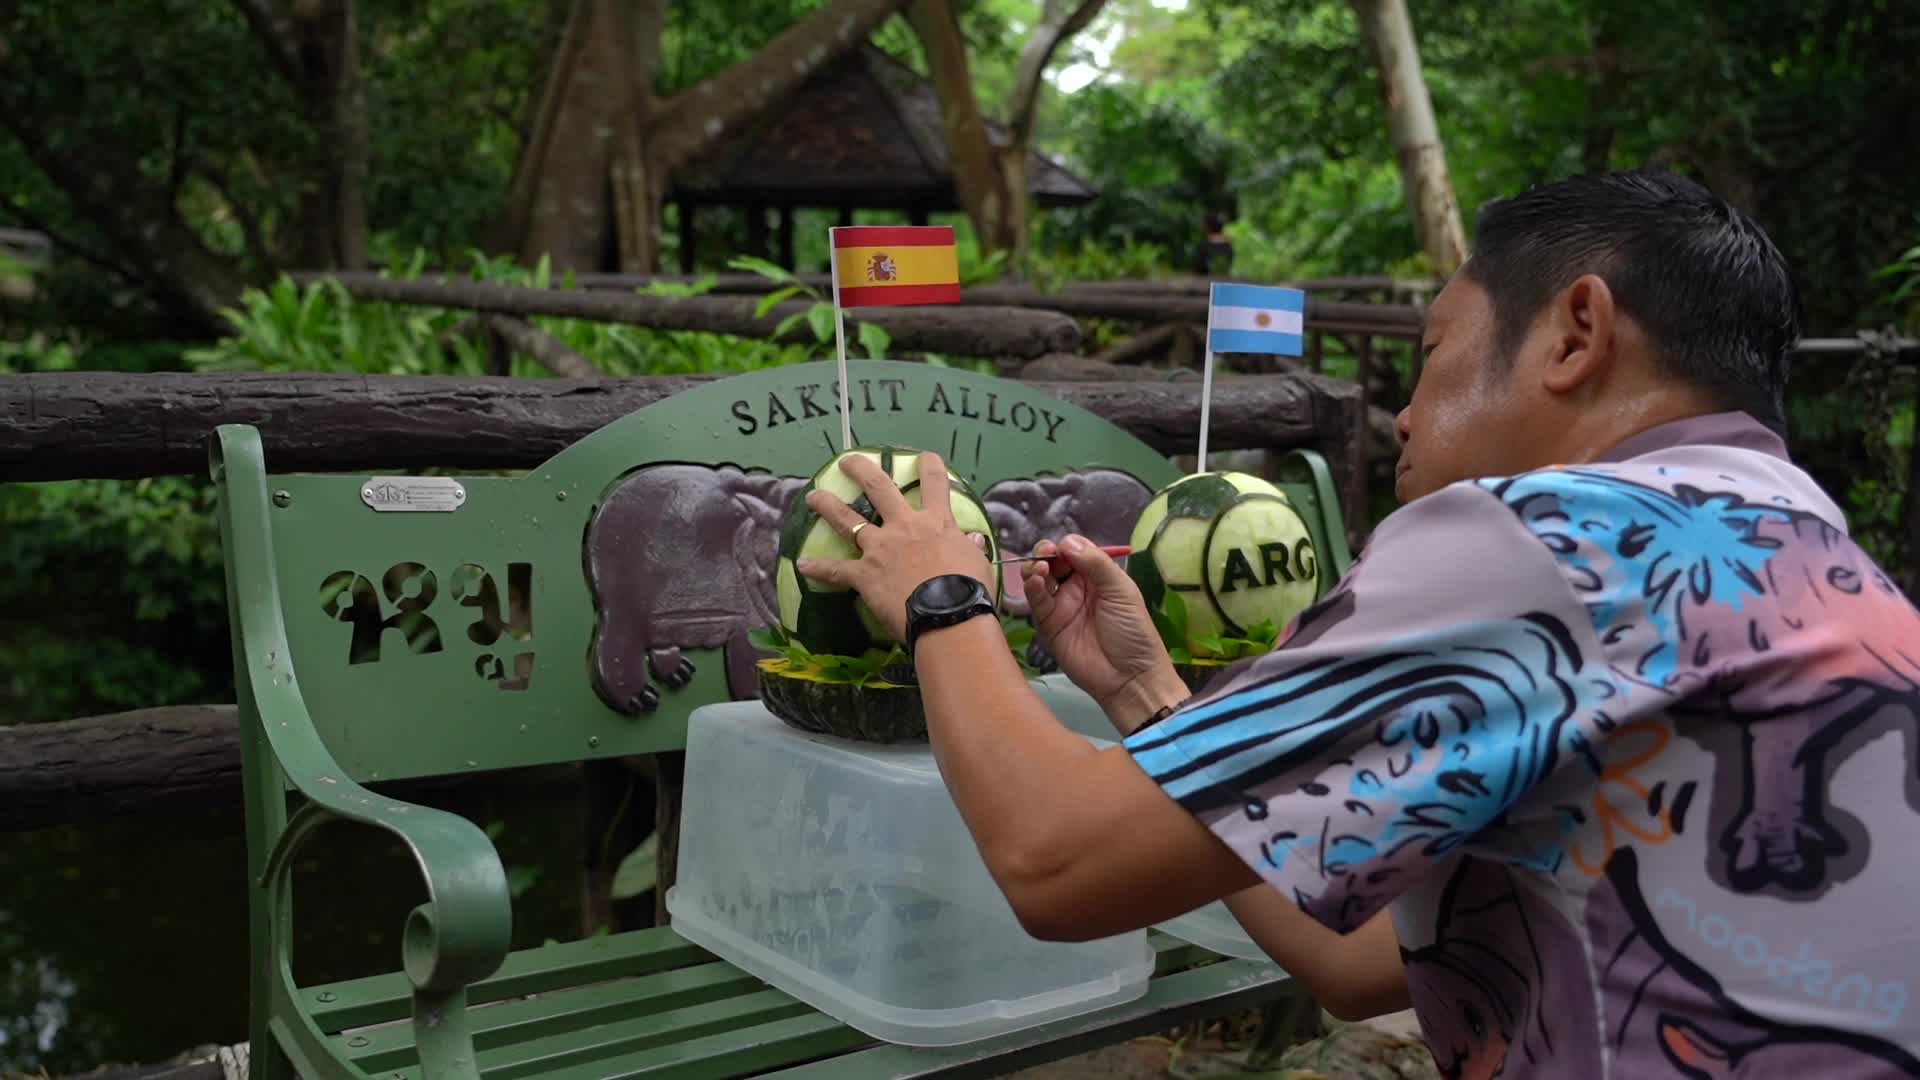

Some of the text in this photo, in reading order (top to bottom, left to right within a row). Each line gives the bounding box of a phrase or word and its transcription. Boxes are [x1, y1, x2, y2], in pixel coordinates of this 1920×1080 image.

[731, 379, 1065, 443] SAKSIT ALLOY
[1221, 537, 1315, 592] ARG
[320, 562, 535, 691] หมู
